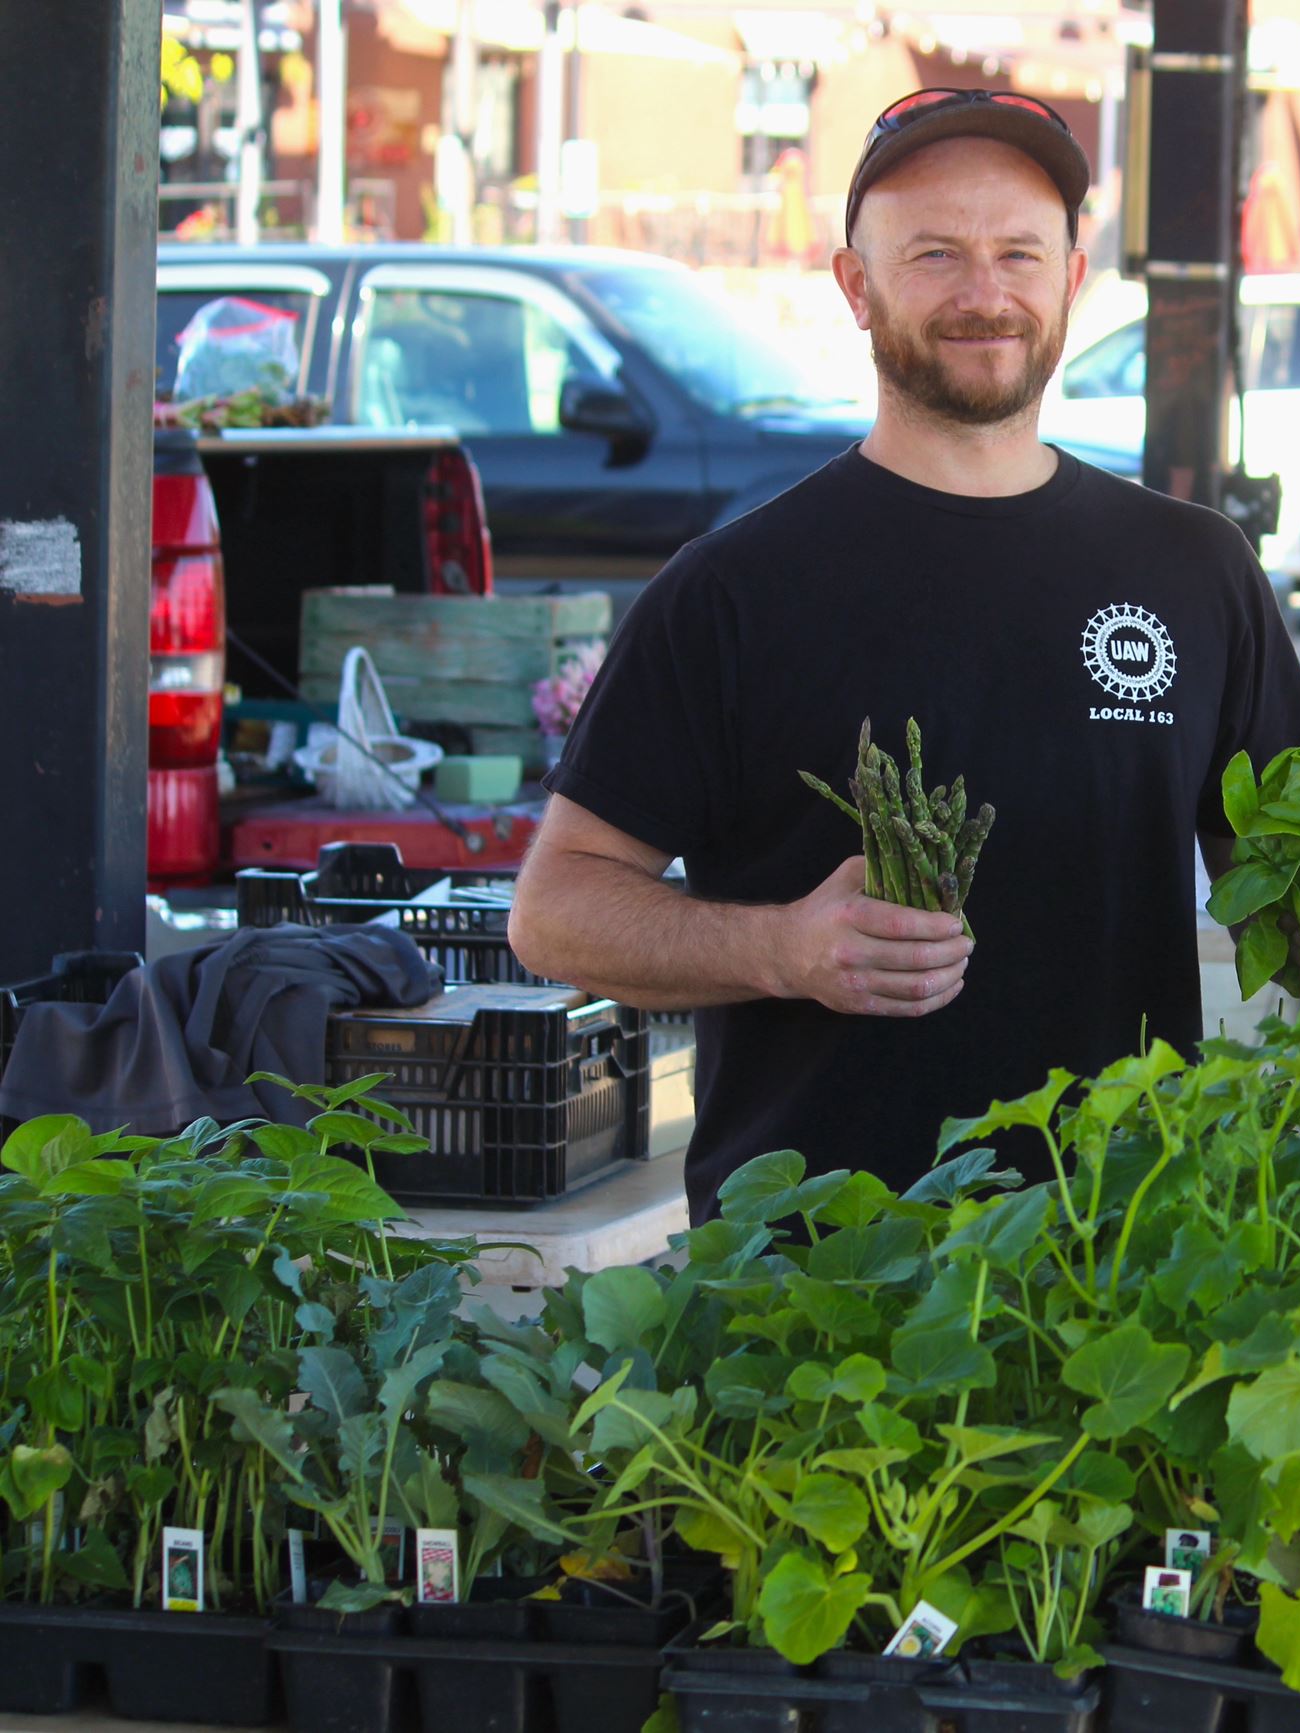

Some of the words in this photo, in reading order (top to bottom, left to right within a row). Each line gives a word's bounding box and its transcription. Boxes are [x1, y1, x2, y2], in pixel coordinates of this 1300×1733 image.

[1110, 640, 1149, 662] UAW
[1089, 707, 1145, 721] LOCAL
[1149, 710, 1174, 725] 163
